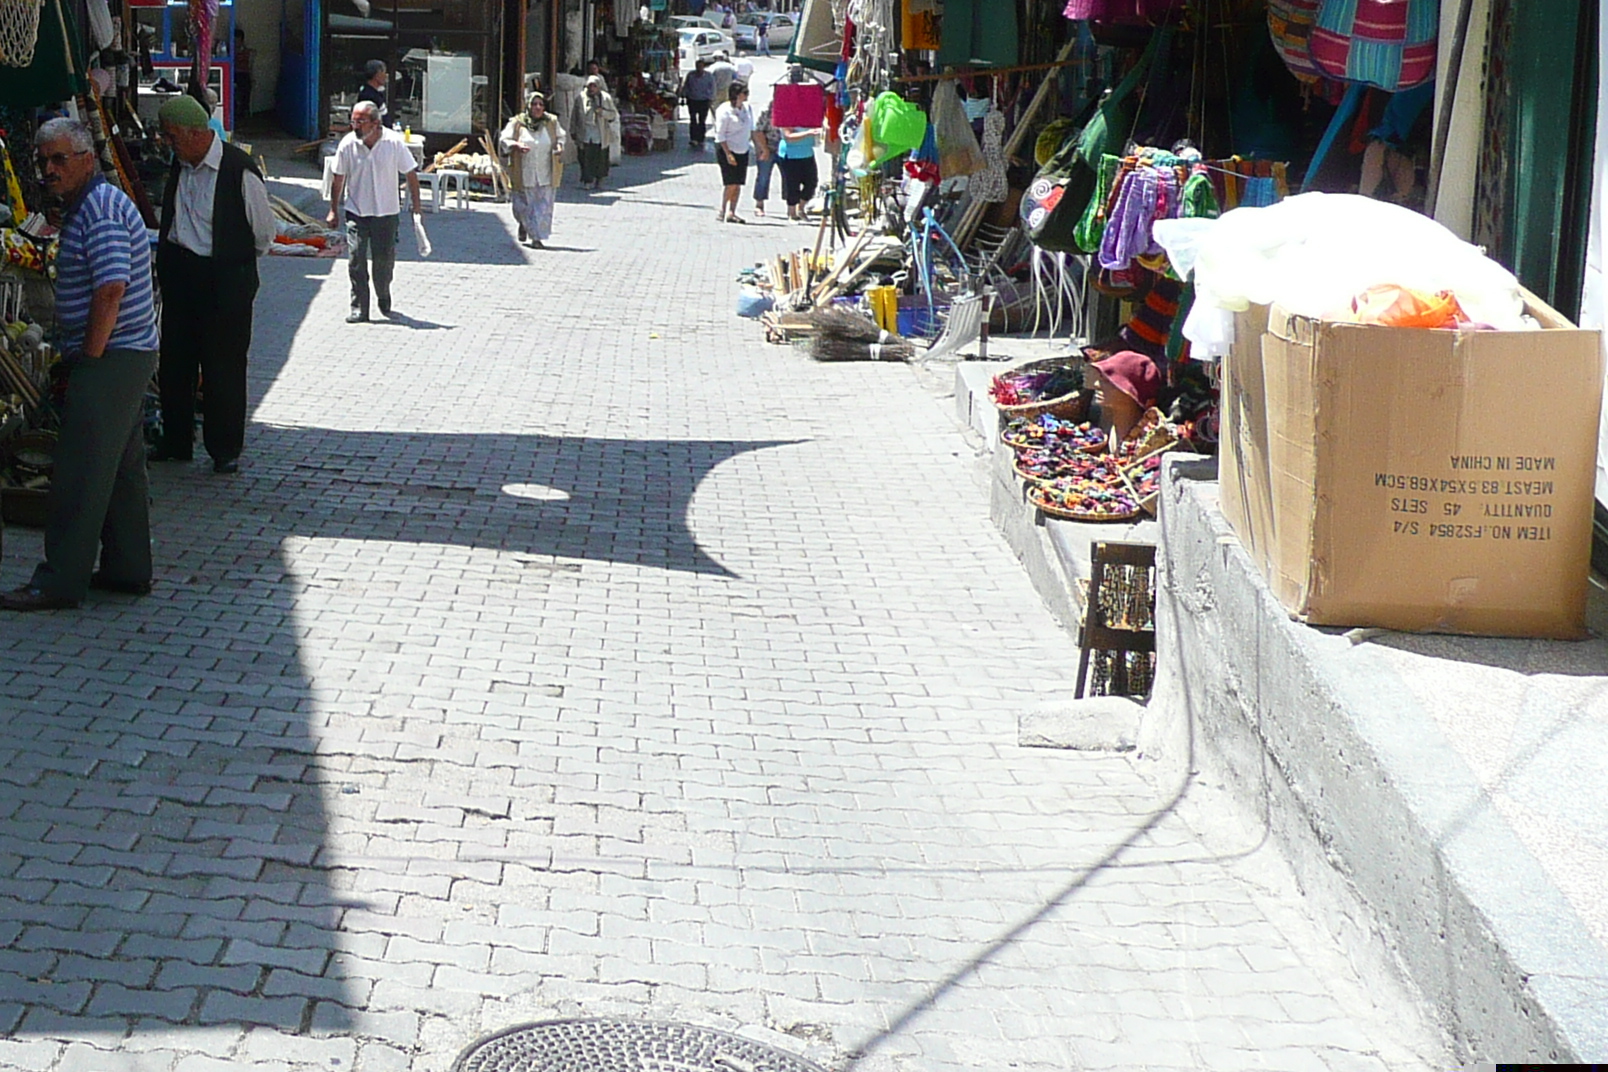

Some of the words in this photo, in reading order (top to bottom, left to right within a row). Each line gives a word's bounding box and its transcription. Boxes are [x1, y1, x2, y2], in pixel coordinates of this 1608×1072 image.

[1450, 455, 1492, 470] CHINA
[1497, 456, 1510, 470] IN
[1515, 455, 1555, 470] MADE
[1391, 497, 1428, 514] SETS
[1443, 501, 1462, 516] 45
[1393, 520, 1420, 536] S/4
[1517, 525, 1551, 541] ITEM
